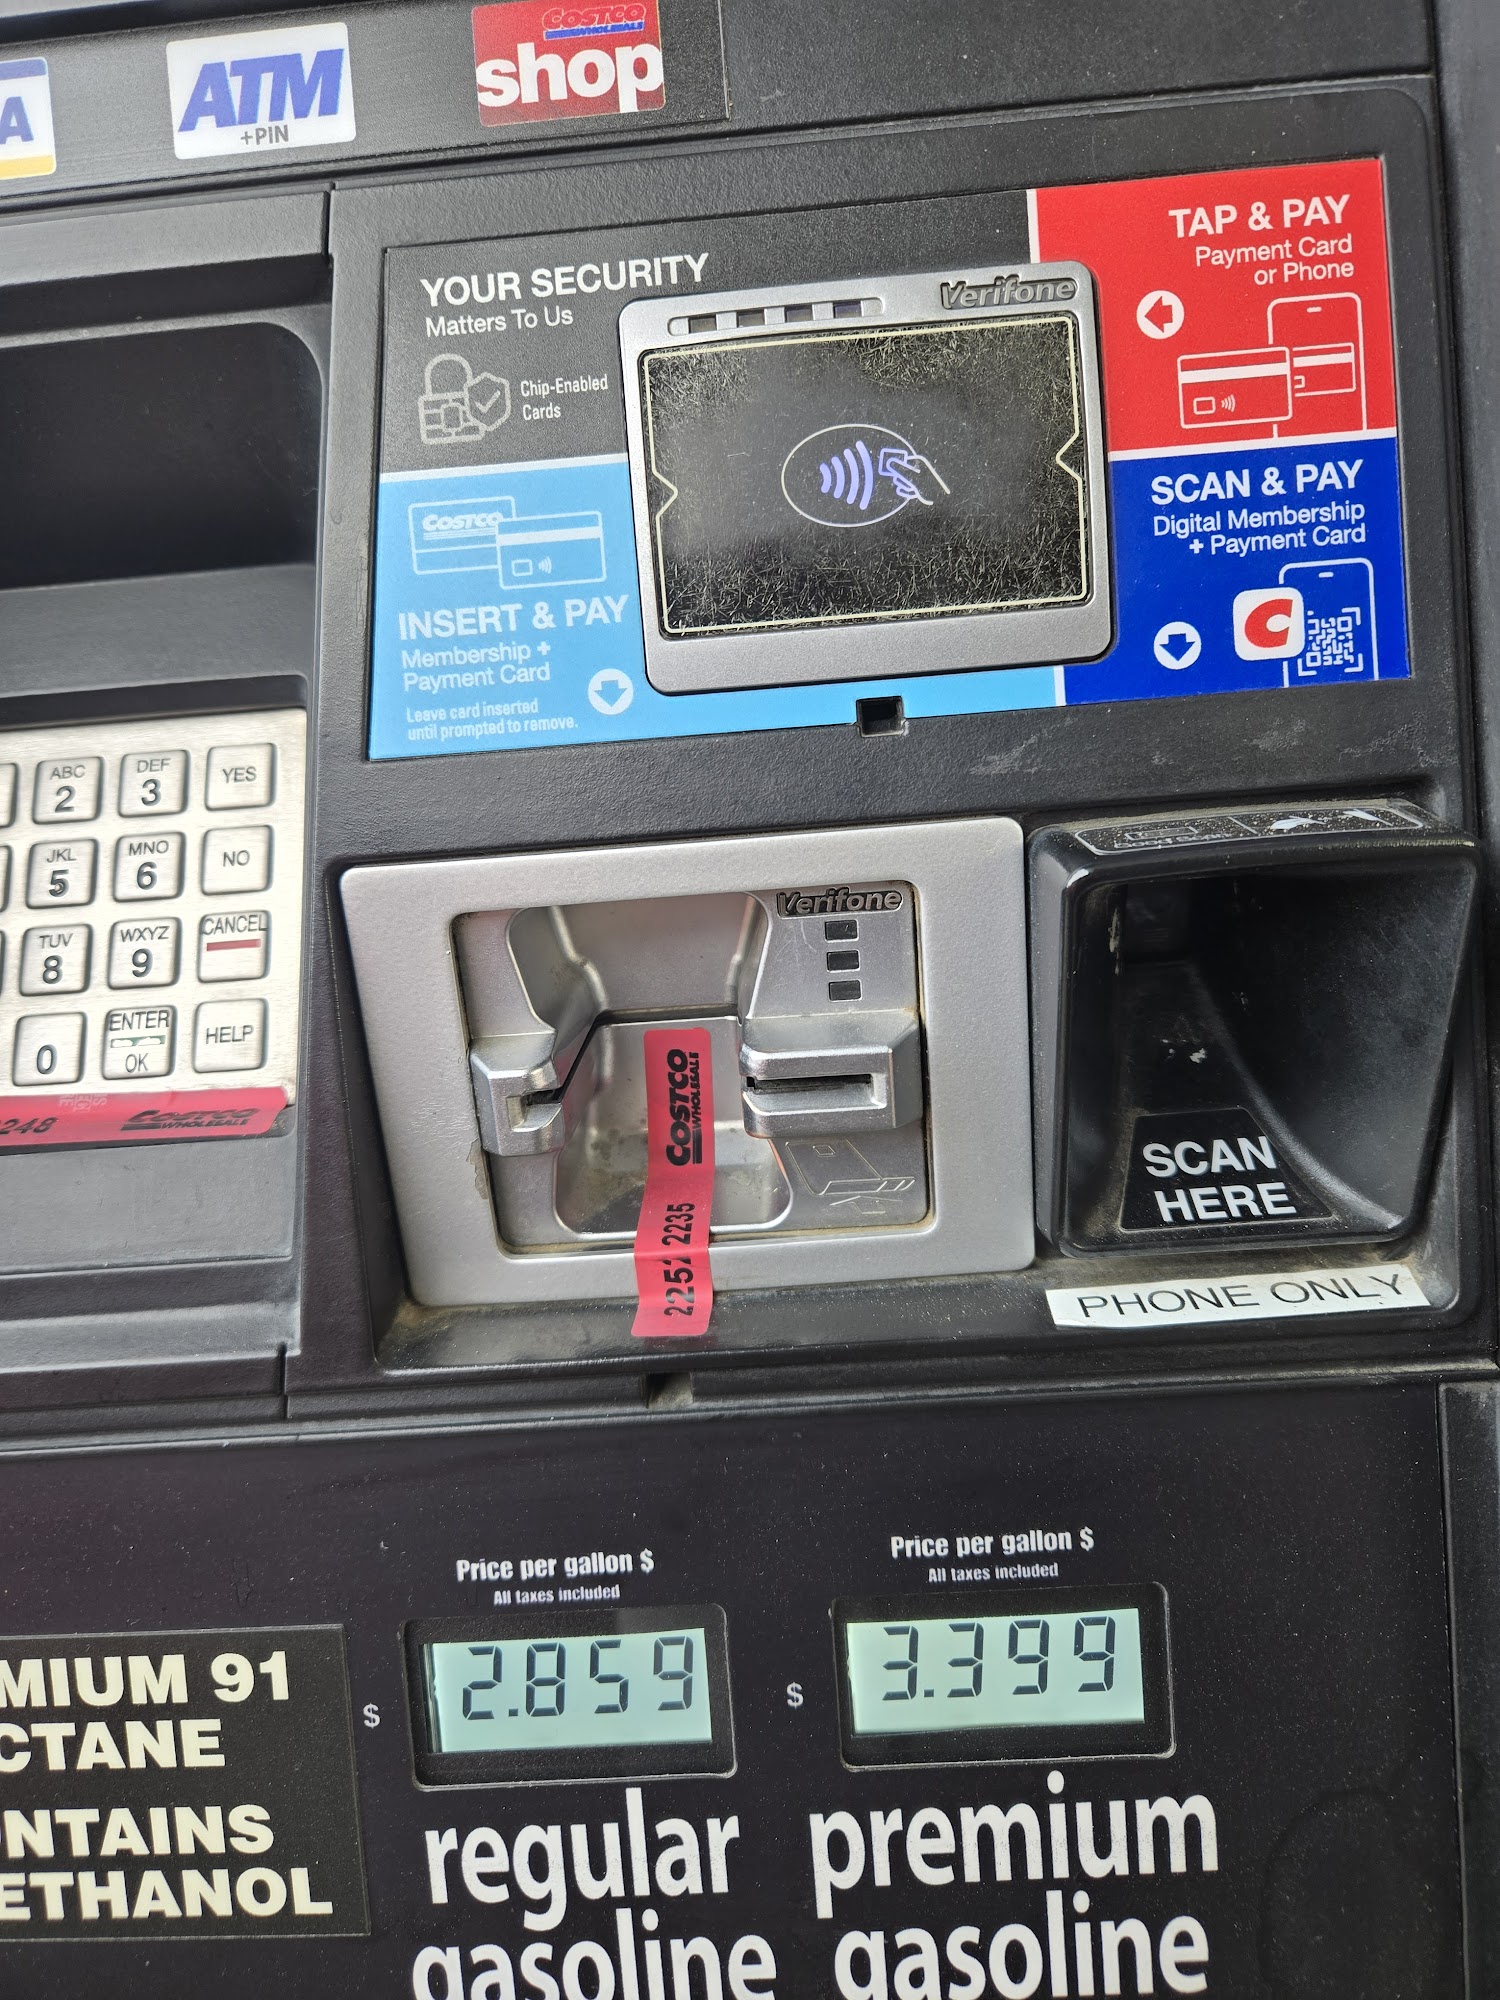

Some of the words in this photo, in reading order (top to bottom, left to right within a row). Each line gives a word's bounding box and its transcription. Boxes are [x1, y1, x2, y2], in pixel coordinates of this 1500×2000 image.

[542, 3, 646, 31] COSTCO
[178, 48, 345, 132] ATM
[476, 43, 664, 113] shop
[241, 125, 289, 145] +PIN
[1169, 205, 1237, 238] TAP
[1248, 201, 1272, 231] &
[1283, 194, 1350, 227] PAY
[1195, 240, 1293, 267] Payment
[1298, 233, 1353, 257] Card
[421, 272, 521, 307] YOUR
[531, 253, 709, 298] SECURITY
[1254, 268, 1276, 286] or
[1283, 260, 1354, 282] Phone
[940, 275, 1078, 310] Verifone
[425, 313, 506, 338] Matters
[511, 308, 538, 329] To
[544, 306, 573, 327] Us
[520, 374, 608, 397] Chip-Enabled
[523, 402, 561, 420] Cards
[1151, 469, 1250, 505] SCAN
[1261, 467, 1287, 495] &
[1296, 459, 1364, 493] PAY
[422, 511, 503, 531] COSTCO
[1153, 511, 1221, 539] Digital
[1227, 500, 1365, 529] Membership
[1189, 540, 1204, 554] +
[1210, 531, 1307, 557] Payment
[1312, 523, 1366, 544] Card
[399, 603, 522, 641] INSERT
[532, 601, 556, 630] &
[565, 594, 629, 627] PAY
[402, 642, 531, 669] Membership
[537, 641, 551, 656] +
[404, 666, 495, 694] Payment
[501, 662, 550, 684] Card
[407, 706, 446, 723] Leave
[450, 702, 480, 720] card
[483, 698, 538, 718] inserted
[408, 722, 437, 741] until
[441, 718, 505, 742] prompted
[508, 719, 521, 733] to
[524, 717, 579, 733] remove.
[50, 764, 86, 780] ABC
[137, 758, 171, 773] DEF
[222, 766, 257, 783] YES
[54, 786, 75, 813] 2
[141, 779, 161, 806] 3
[47, 848, 76, 864] JKL
[129, 840, 169, 856] MNO
[223, 850, 250, 867] NO
[49, 869, 69, 897] 5
[137, 861, 157, 890] 6
[776, 887, 903, 917] Verifone
[121, 925, 169, 943] WXYZ
[202, 914, 267, 936] CANCEL
[40, 933, 73, 948] TUV
[42, 955, 63, 984] 8
[131, 948, 152, 977] 9
[109, 1009, 169, 1032] ENTER
[206, 1024, 254, 1044] HELP
[36, 1044, 57, 1075] 0
[125, 1053, 148, 1073] OK
[0, 1117, 57, 1135] 248
[128, 1108, 260, 1123] COSTCO
[666, 1049, 691, 1166] COSTCO
[161, 1118, 249, 1130] WHOLESALE
[1141, 1136, 1277, 1177] SCAN
[1155, 1182, 1297, 1224] HERE
[661, 1203, 695, 1246] 2235
[1077, 1284, 1260, 1319] PHONE
[1270, 1273, 1402, 1305] ONLY
[891, 1535, 949, 1558] Price
[957, 1536, 994, 1557] per
[1001, 1529, 1072, 1555] gallon
[1080, 1526, 1095, 1552] $
[456, 1558, 513, 1582] Price
[520, 1558, 557, 1580] per
[564, 1551, 633, 1577] gallon
[640, 1548, 655, 1574] $
[928, 1567, 946, 1583] All
[951, 1568, 990, 1581] taxes
[995, 1562, 1058, 1579] included
[493, 1589, 511, 1606] All
[515, 1589, 555, 1604] taxes
[558, 1584, 621, 1602] included
[882, 1616, 1116, 1700] 3.399
[211, 1651, 289, 1702] 91
[463, 1636, 694, 1720] 2.859
[786, 1682, 803, 1708] $
[363, 1703, 380, 1728] $
[0, 1804, 274, 1858] NTAINS
[809, 1770, 1218, 1919] premium
[425, 1787, 740, 1931] regular
[0, 1867, 333, 1921] ETHANOL
[834, 1890, 1209, 2000] gasoline
